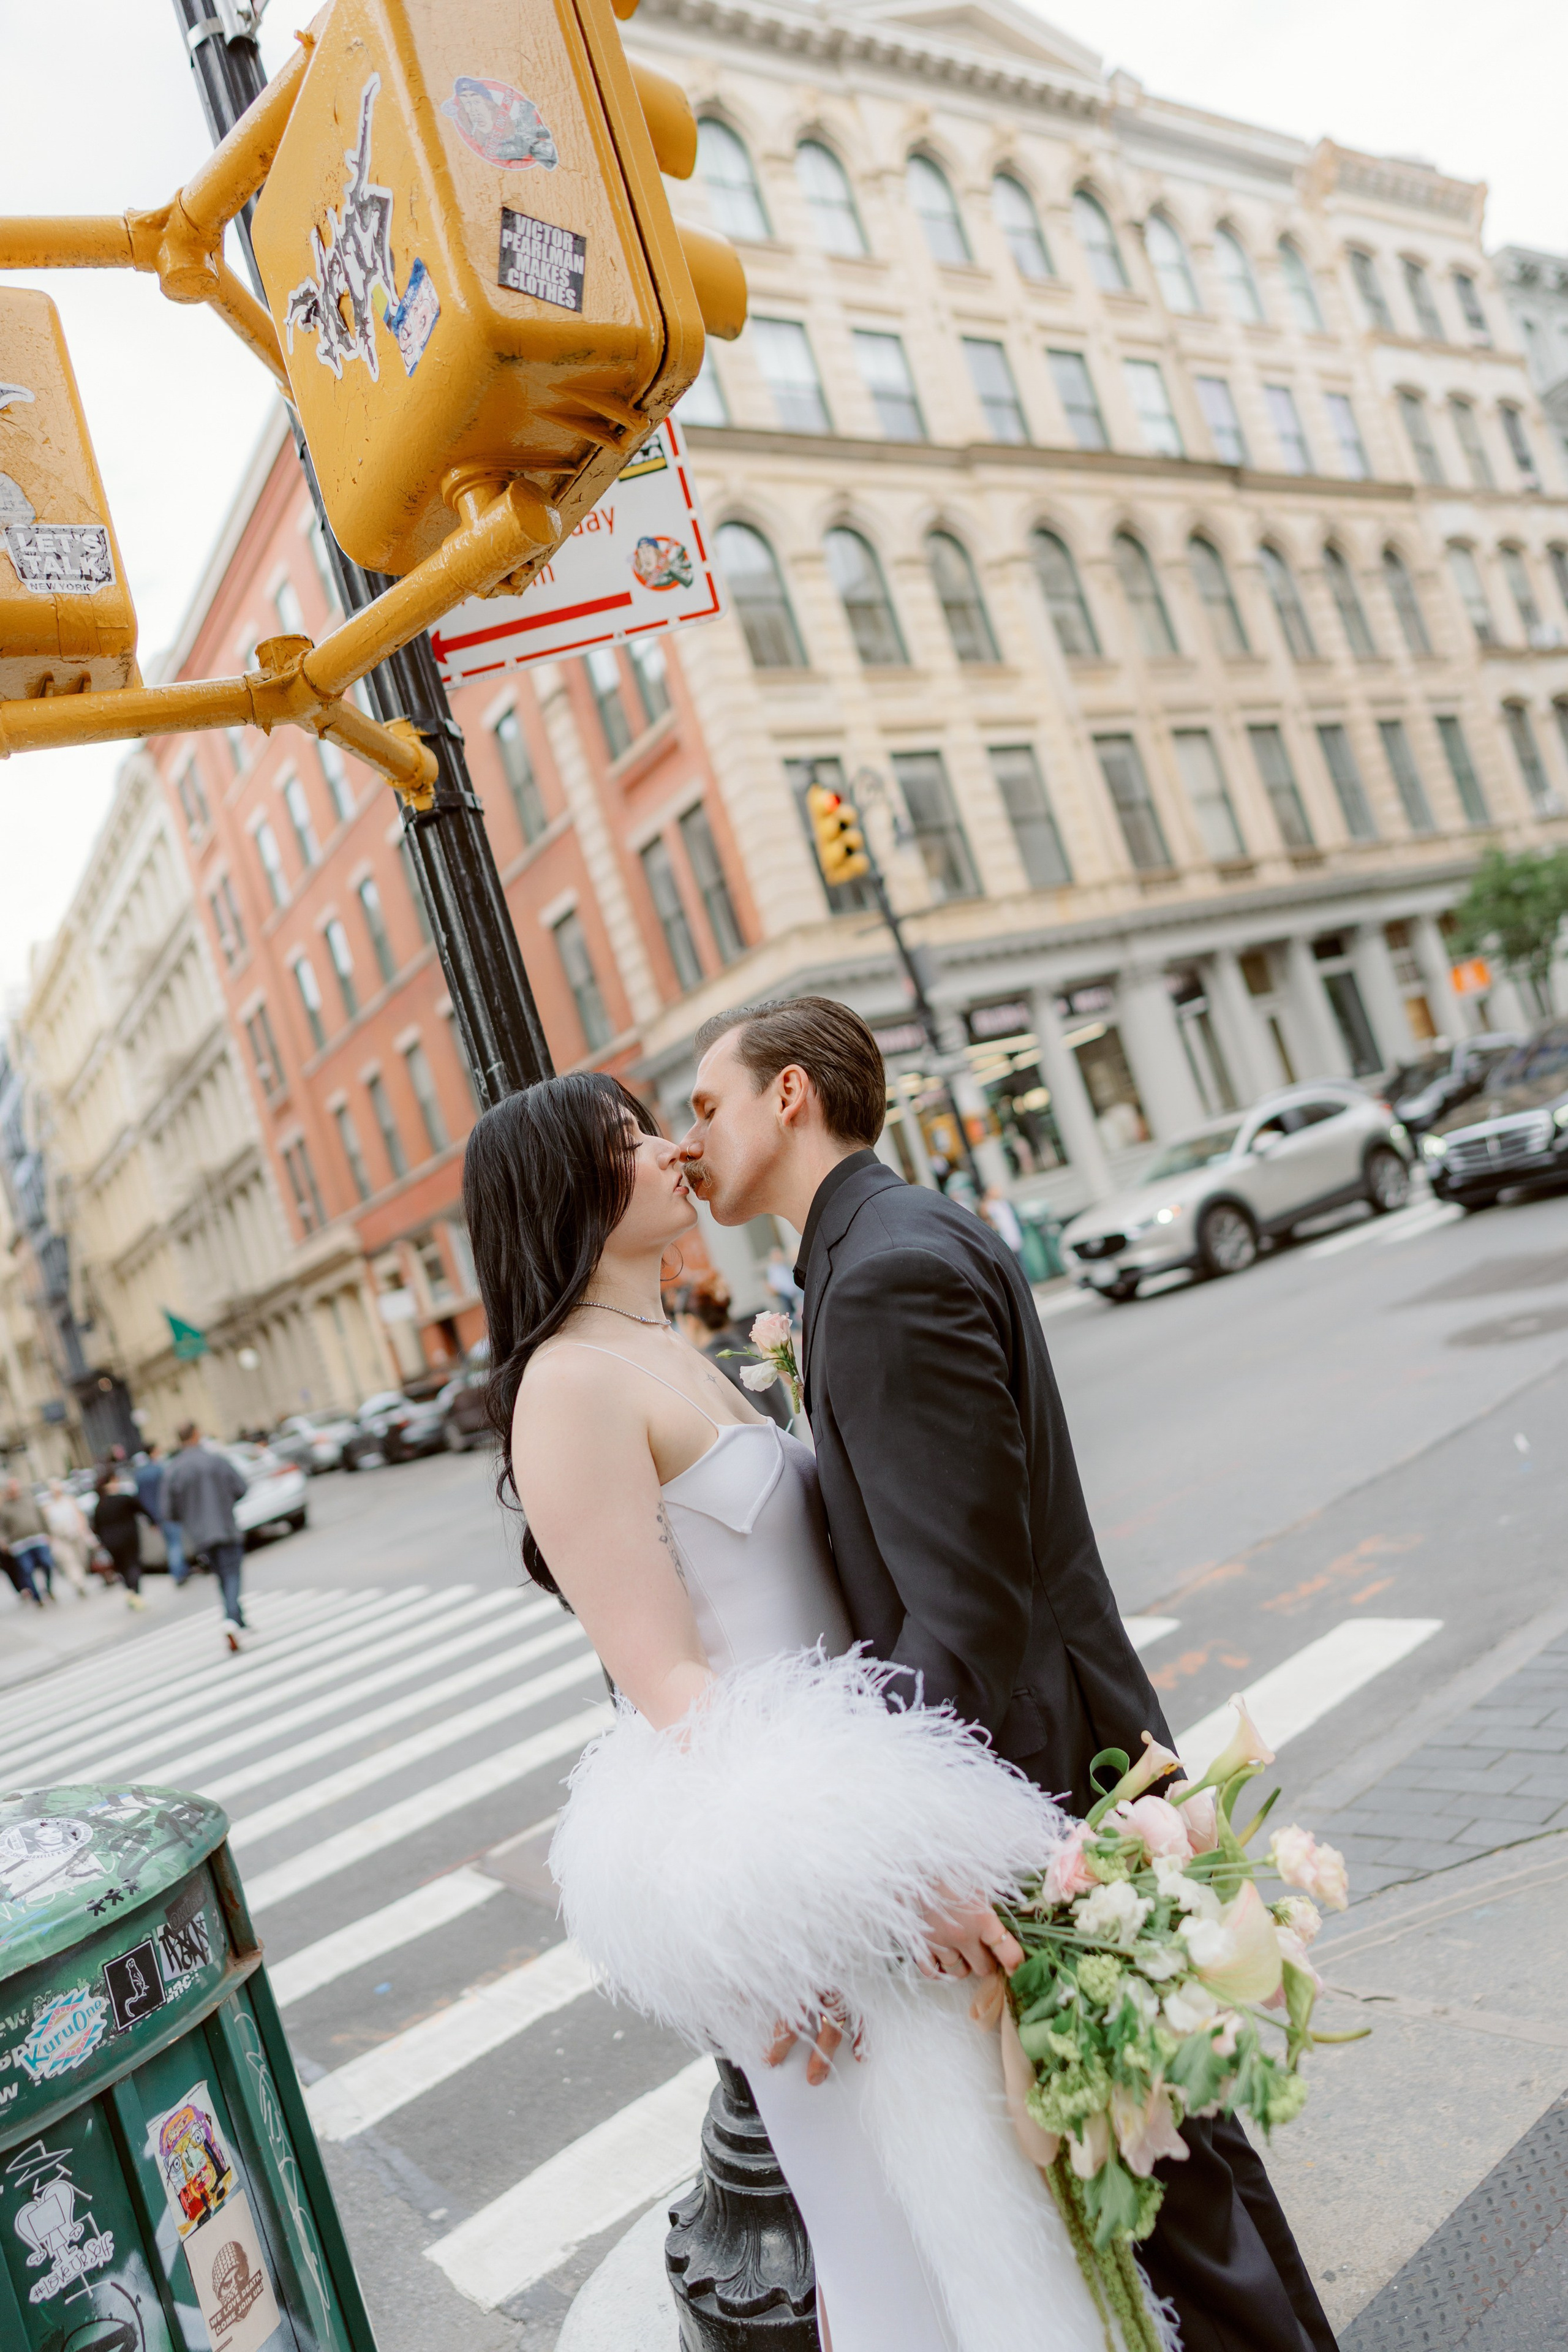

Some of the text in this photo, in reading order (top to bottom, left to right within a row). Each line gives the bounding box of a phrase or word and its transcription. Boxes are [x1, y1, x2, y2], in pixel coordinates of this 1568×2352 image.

[495, 107, 510, 129] ONLY
[502, 228, 584, 275] PEARLMAN
[515, 214, 574, 252] VICTOR
[507, 268, 576, 309] CLOTHES
[515, 252, 570, 288] MAKES
[16, 532, 102, 554] LET'S
[23, 555, 105, 576] TALK
[23, 1999, 102, 2072] KuruOne
[210, 2273, 263, 2328] WE LOVE DEATH,
[216, 2311, 237, 2334] COME
[238, 2294, 253, 2314] JOIN
[253, 2282, 264, 2297] US!
